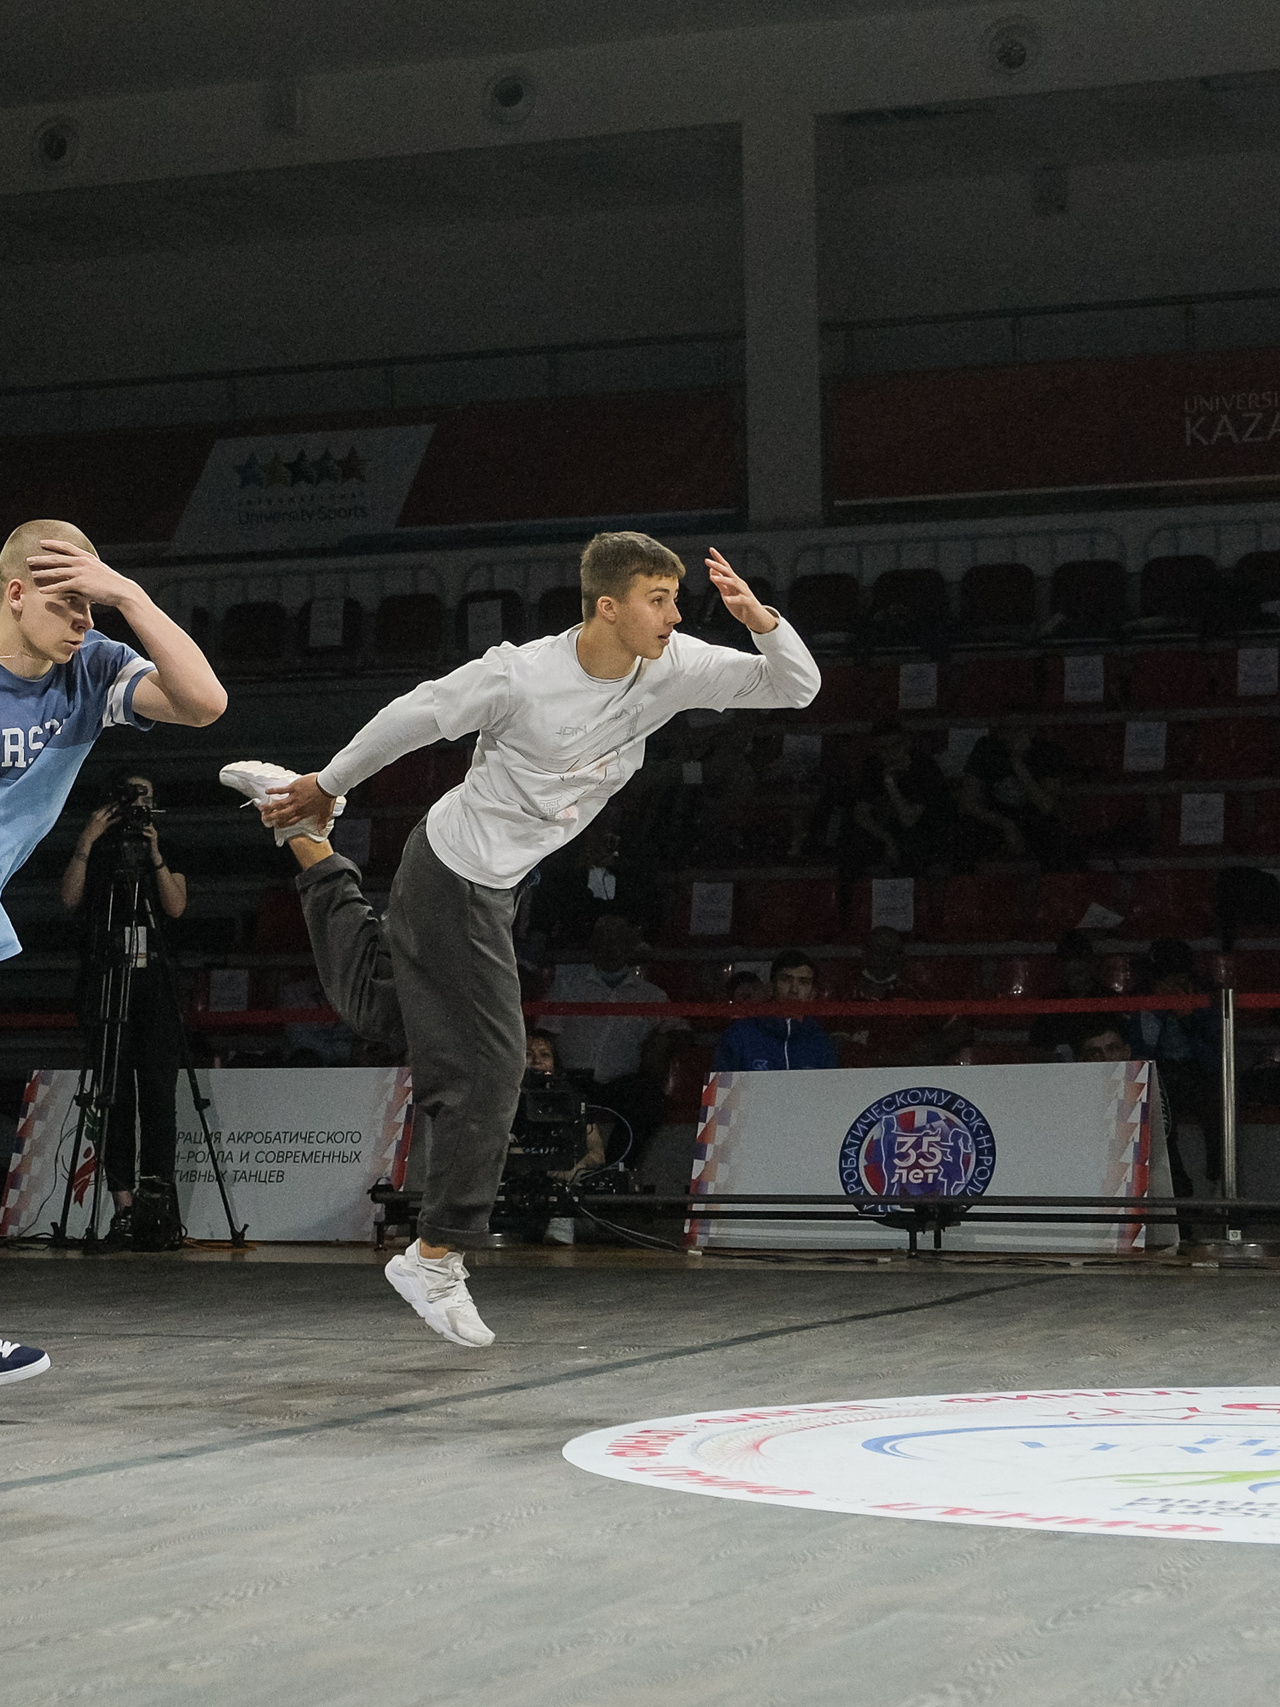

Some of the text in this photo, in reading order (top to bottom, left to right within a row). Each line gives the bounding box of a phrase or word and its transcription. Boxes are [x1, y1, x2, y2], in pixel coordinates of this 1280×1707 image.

[318, 504, 369, 521] Sports
[226, 1130, 362, 1144] АКРОБАТИЧЕСКОГО
[239, 1151, 250, 1164] И
[255, 1151, 362, 1164] СОВРЕМЕННЫХ
[892, 1136, 942, 1167] 35
[233, 1170, 285, 1184] ТАНЦЕВ
[695, 1404, 890, 1425] ФИНАЛ
[605, 1429, 699, 1458] ФИНАЛ
[627, 1465, 817, 1496] ФИНАЛ
[867, 1502, 1224, 1533] ФИНАЛ
